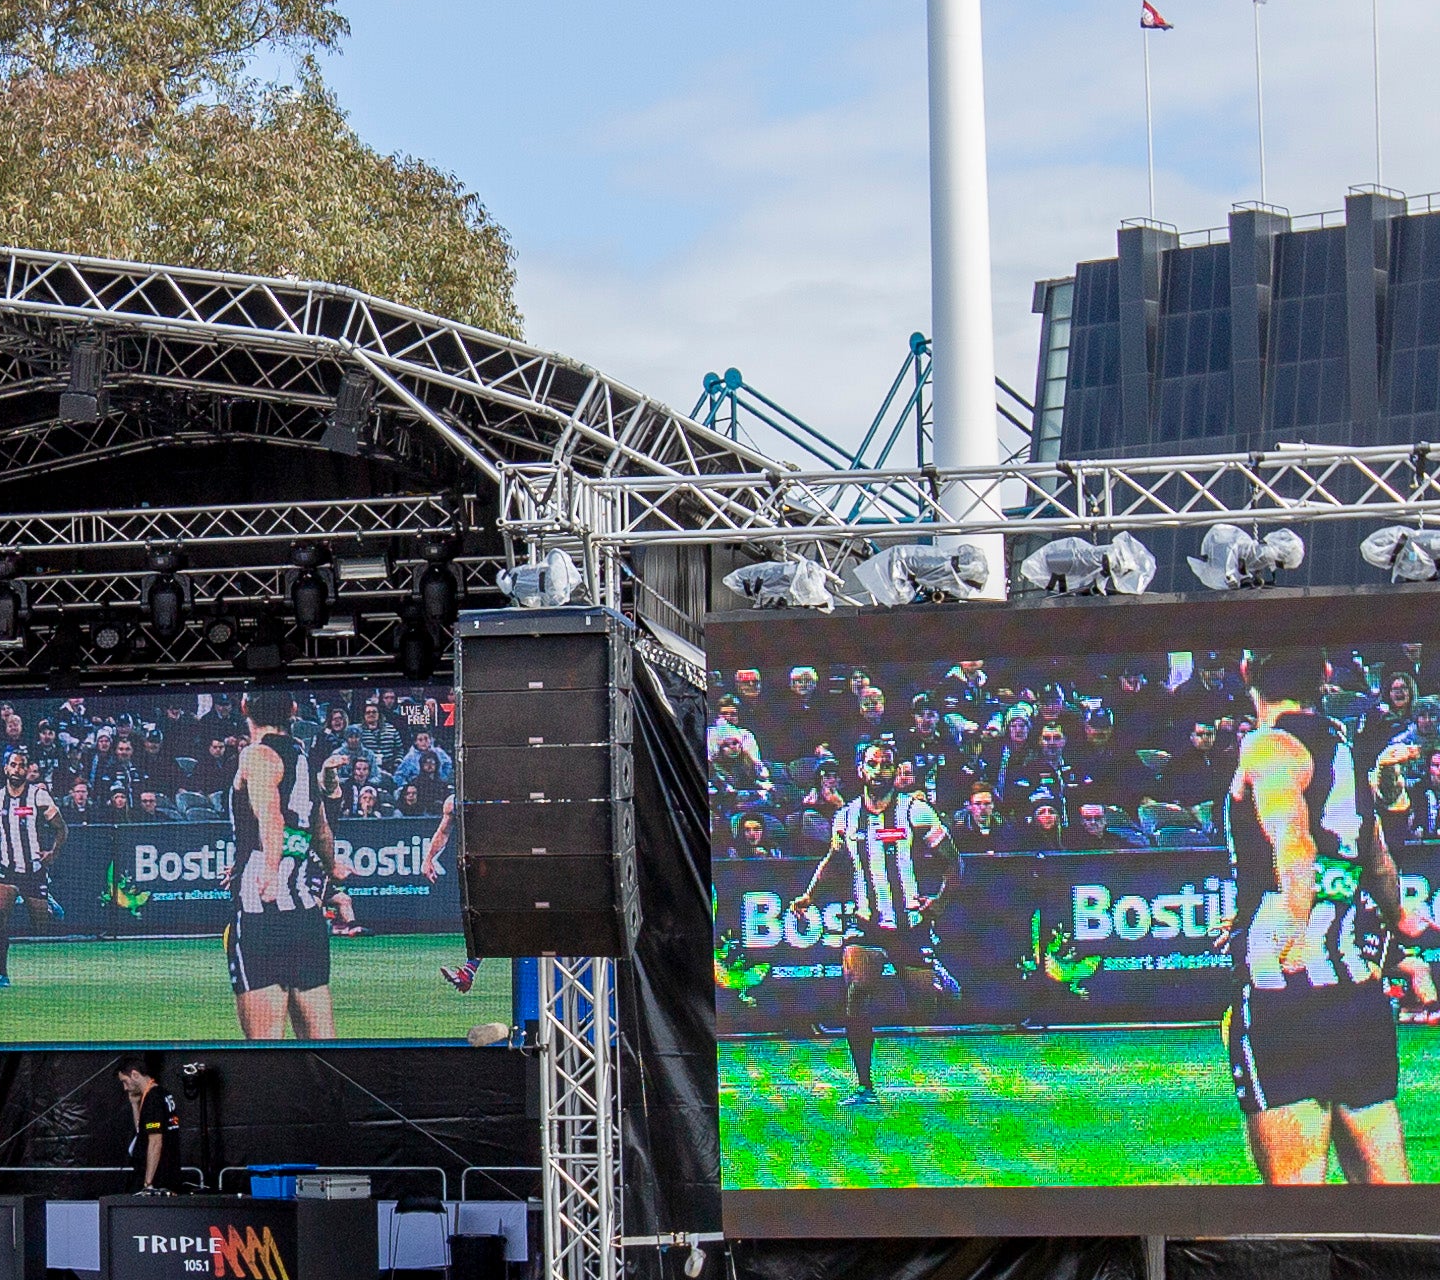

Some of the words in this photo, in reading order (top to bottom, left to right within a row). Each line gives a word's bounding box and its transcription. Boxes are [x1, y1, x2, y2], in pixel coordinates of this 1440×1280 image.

[152, 890, 183, 902] smart
[184, 888, 231, 902] adhesive
[347, 886, 378, 896] smart
[132, 1235, 223, 1255] TRIPLE
[183, 1260, 211, 1273] 105.1
